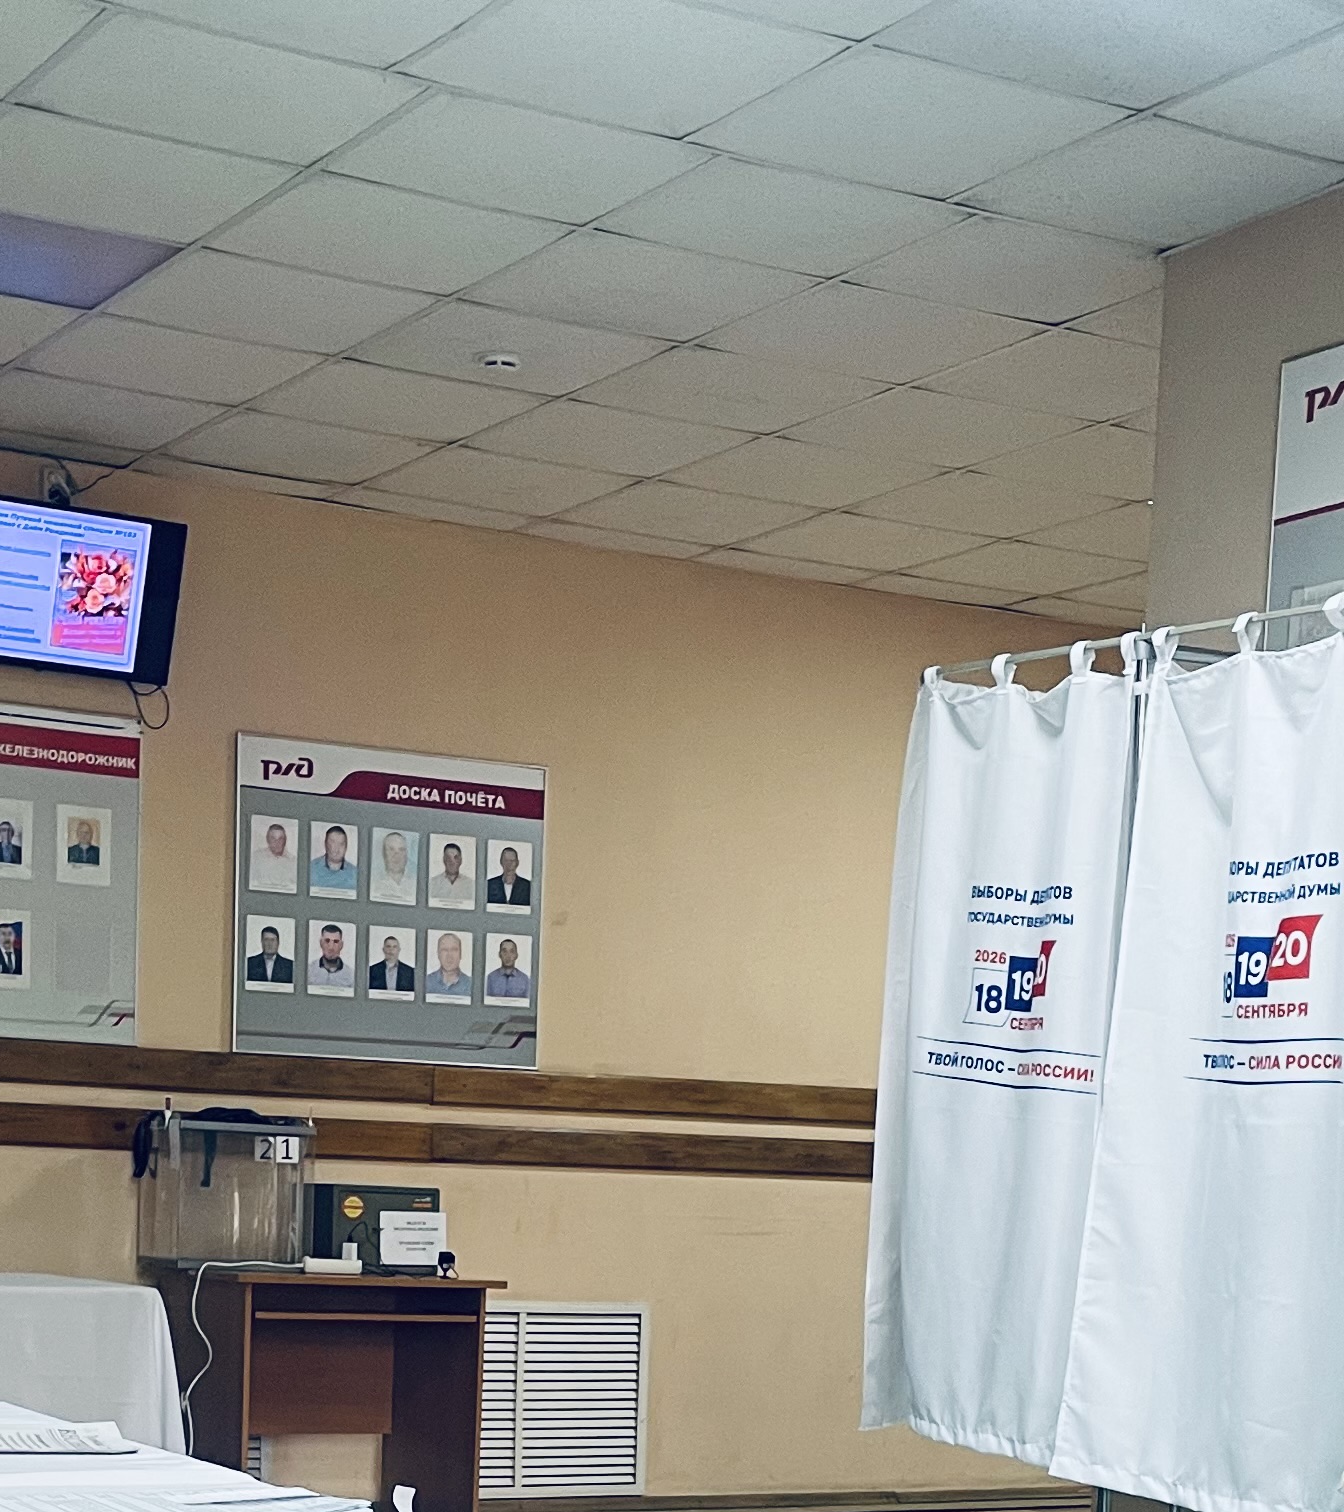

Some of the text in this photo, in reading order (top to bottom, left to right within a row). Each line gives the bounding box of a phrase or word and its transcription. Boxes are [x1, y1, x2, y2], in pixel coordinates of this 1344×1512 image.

[387, 784, 506, 810] ДОСКА ПОЧЁТА
[1297, 882, 1341, 900] ДУМЫ
[974, 950, 1006, 964] 2026
[1237, 951, 1268, 986] 19
[1272, 930, 1308, 968] 20
[975, 984, 1003, 1014] 18
[1012, 971, 1034, 1000] 19
[1236, 1002, 1308, 1018] СЕНТЯБРЯ
[928, 1052, 958, 1068] ТВОЙ
[960, 1056, 1004, 1074] ГОЛОС
[1248, 1056, 1280, 1070] СИЛА
